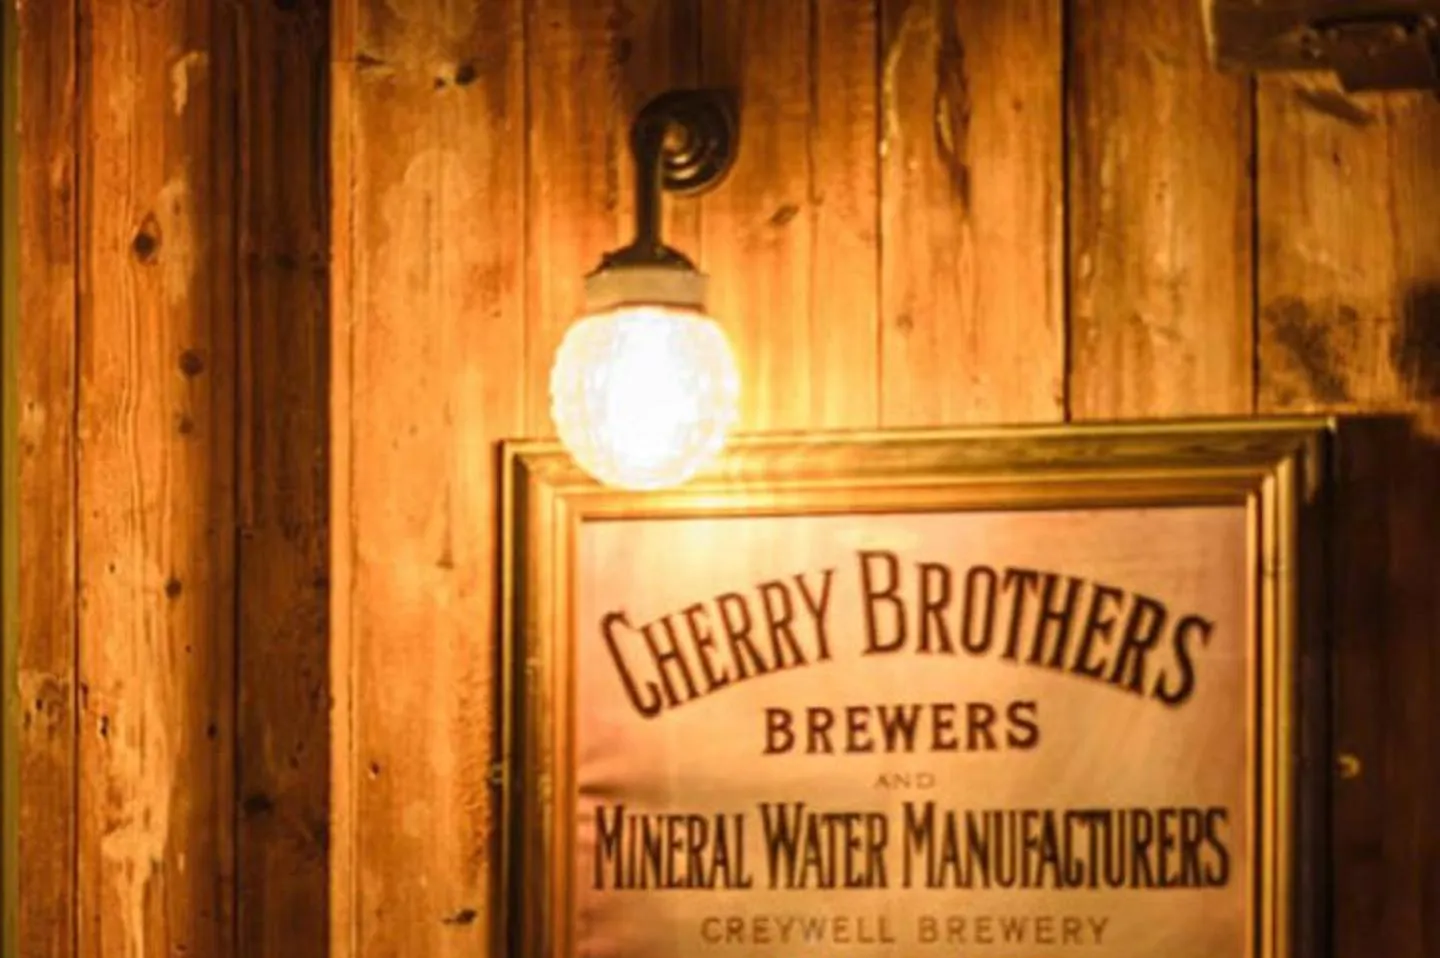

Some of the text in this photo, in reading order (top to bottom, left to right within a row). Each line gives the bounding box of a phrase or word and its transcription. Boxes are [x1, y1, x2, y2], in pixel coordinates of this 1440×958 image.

[600, 549, 1216, 719] CHERRY BROTHERS
[762, 701, 1041, 755] BREWERS
[873, 772, 936, 791] AND
[592, 801, 1231, 890] MINERAL WATER MANUFACTURERS
[700, 916, 1111, 946] CREYWELL BREWERY
